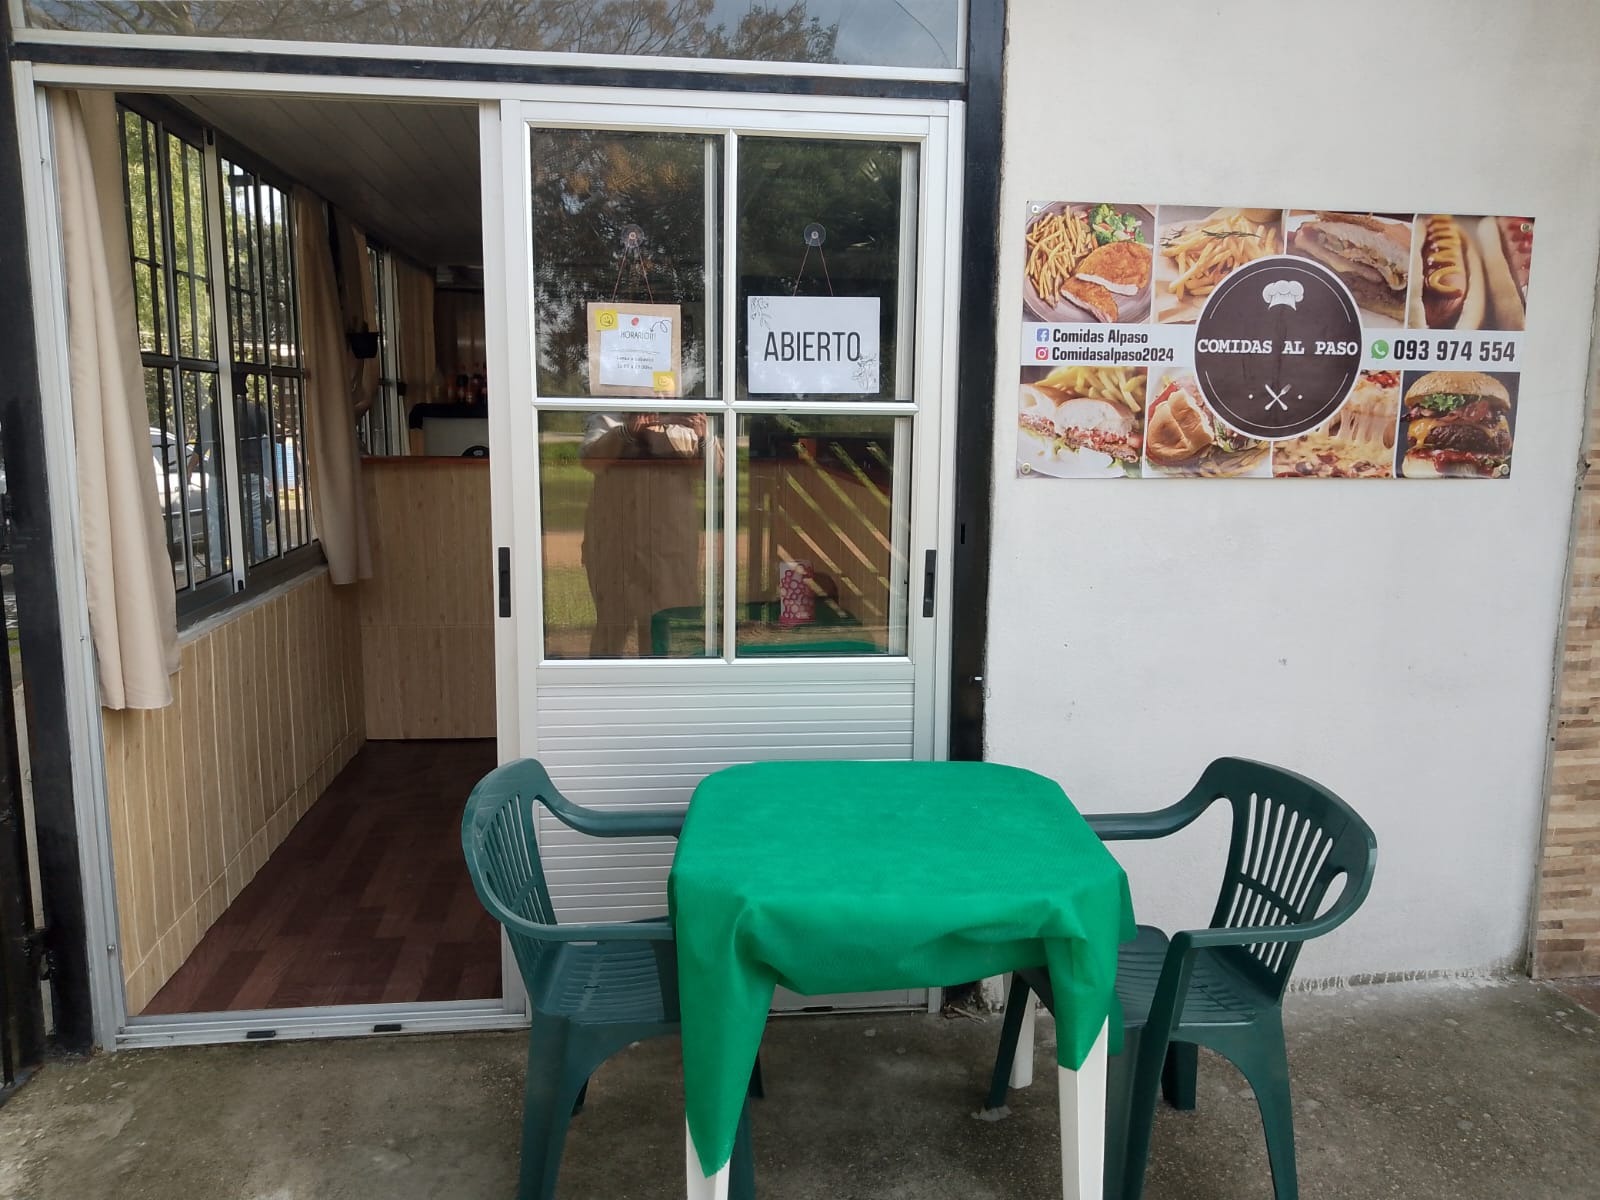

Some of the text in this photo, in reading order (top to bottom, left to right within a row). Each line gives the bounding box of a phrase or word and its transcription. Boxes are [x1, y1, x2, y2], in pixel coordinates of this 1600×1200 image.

[1052, 328, 1148, 346] Comidas Alpaso
[763, 331, 861, 362] ABIERTO
[1052, 346, 1174, 364] Comidasalpaso2024
[1197, 338, 1358, 356] COMIDAS AL PASO
[1393, 339, 1515, 362] 093 974 554
